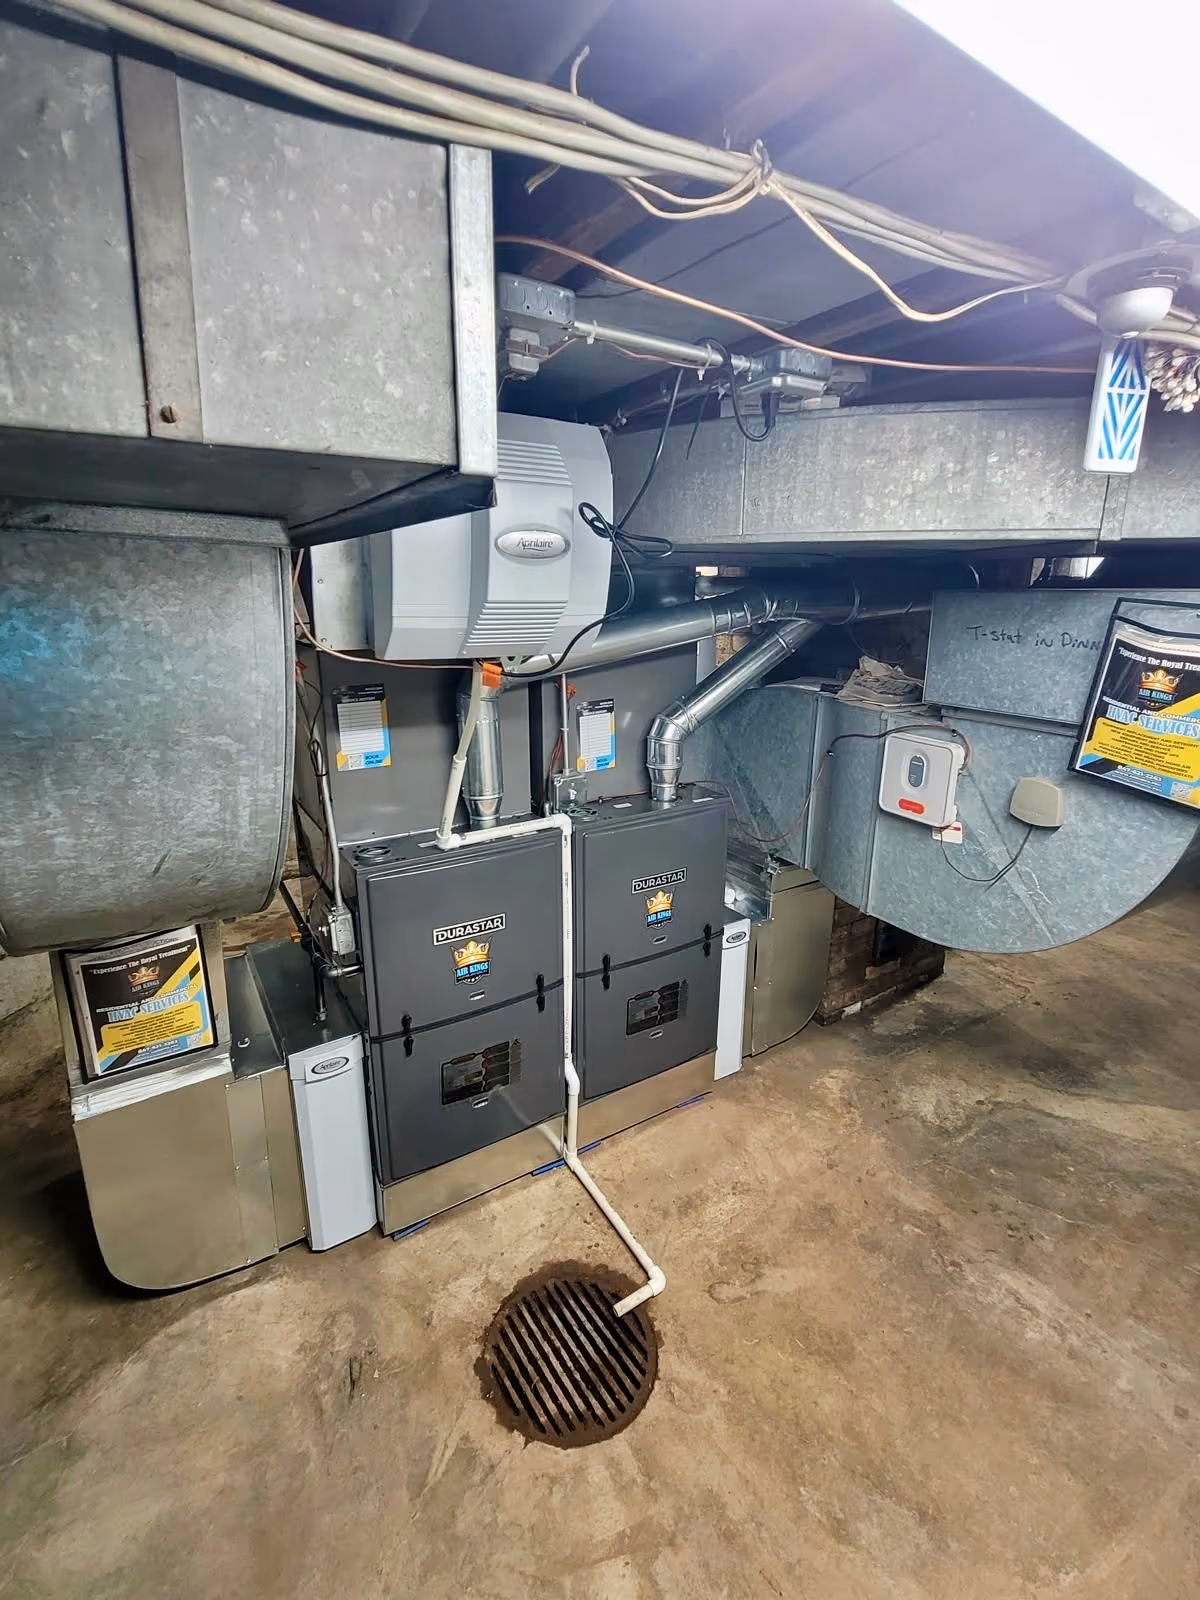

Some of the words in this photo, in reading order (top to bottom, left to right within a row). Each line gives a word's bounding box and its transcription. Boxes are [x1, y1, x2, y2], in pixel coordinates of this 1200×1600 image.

[517, 537, 554, 550] Aprilaire
[966, 626, 1022, 644] T-stat
[1147, 656, 1161, 665] The
[1161, 660, 1184, 669] Royal
[1138, 689, 1150, 697] AIR
[1151, 691, 1173, 700] KINGS
[1106, 704, 1137, 724] HVAC
[1139, 714, 1199, 737] SERVICES
[634, 871, 685, 891] DURASTAR
[648, 914, 657, 922] AIR
[657, 910, 672, 920] KINGS
[436, 917, 503, 942] DURASTAR
[128, 959, 139, 968] The
[140, 955, 158, 965] Royal
[456, 968, 469, 977] AIR
[469, 962, 489, 973] KINGS
[131, 984, 141, 992] AIR
[143, 980, 160, 990] KINGS
[96, 1002, 140, 1013] RESIDENTIAL
[140, 996, 156, 1004] AND
[108, 1008, 138, 1022] HVAC
[139, 992, 190, 1015] SERVICES
